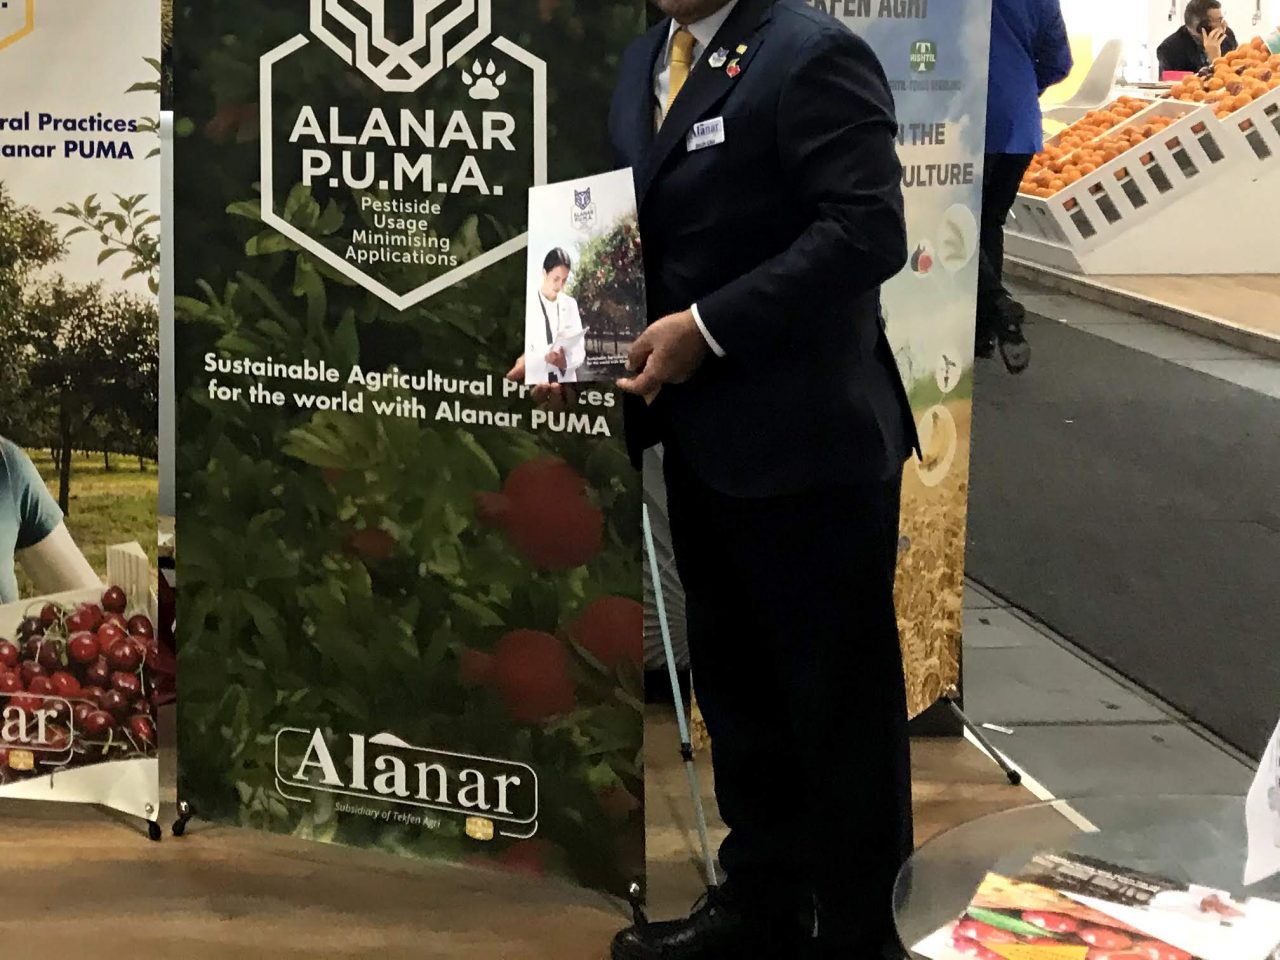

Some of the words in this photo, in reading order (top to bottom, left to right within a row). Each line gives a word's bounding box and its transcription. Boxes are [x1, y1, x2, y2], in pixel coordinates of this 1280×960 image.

[38, 112, 138, 134] Practices
[288, 105, 517, 151] ALANAR
[908, 122, 946, 146] THE
[64, 140, 134, 160] PUMA
[301, 148, 504, 196] P.U.M.A.
[360, 196, 441, 215] Pestiside
[373, 213, 428, 234] Usage
[351, 229, 451, 253] Minimising
[344, 244, 458, 267] Applications
[203, 352, 340, 384] Sustainable
[347, 364, 493, 398] Agricultural
[503, 377, 616, 408] Prces
[207, 379, 242, 401] for
[249, 384, 286, 407] the
[292, 390, 364, 414] world
[372, 396, 426, 420] with
[434, 401, 523, 429] Alanar
[531, 409, 612, 438] PUMA
[292, 727, 521, 815] Alanar
